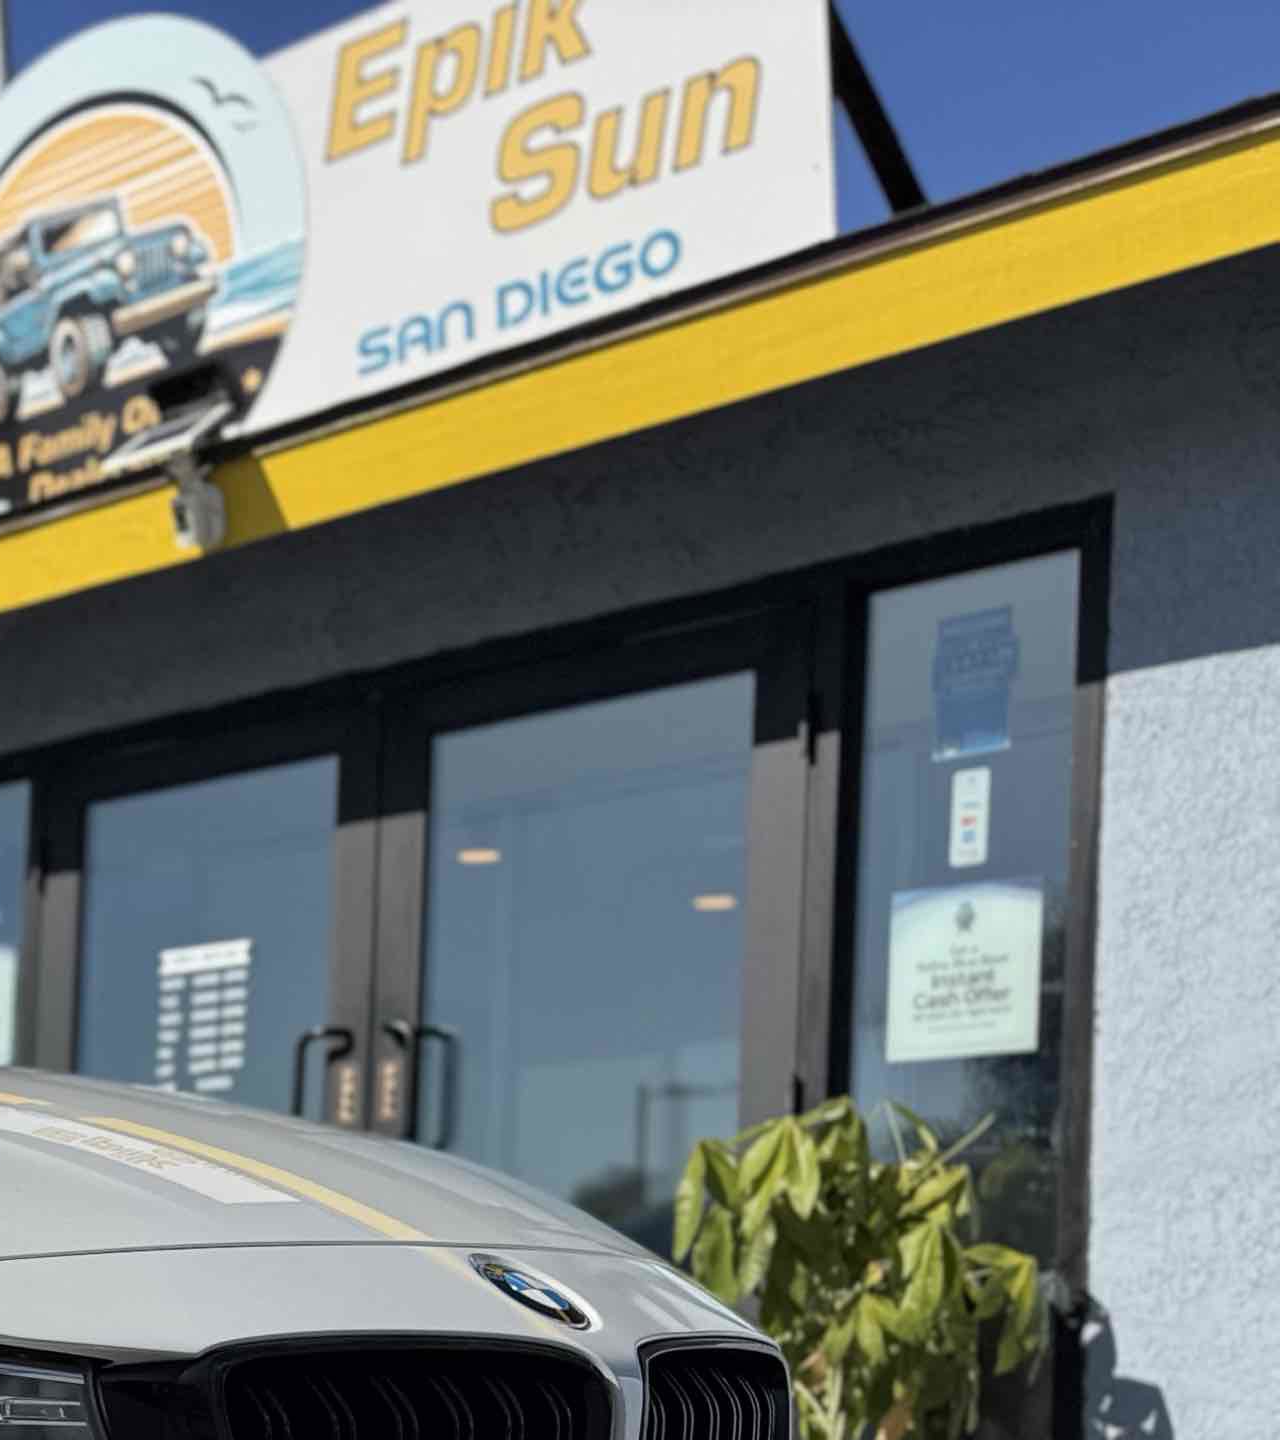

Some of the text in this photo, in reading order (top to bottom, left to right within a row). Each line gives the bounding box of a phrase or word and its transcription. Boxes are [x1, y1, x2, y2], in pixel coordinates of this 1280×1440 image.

[323, 0, 592, 167] Epik
[489, 54, 763, 236] Sun
[356, 228, 682, 377] SAN DIEGO
